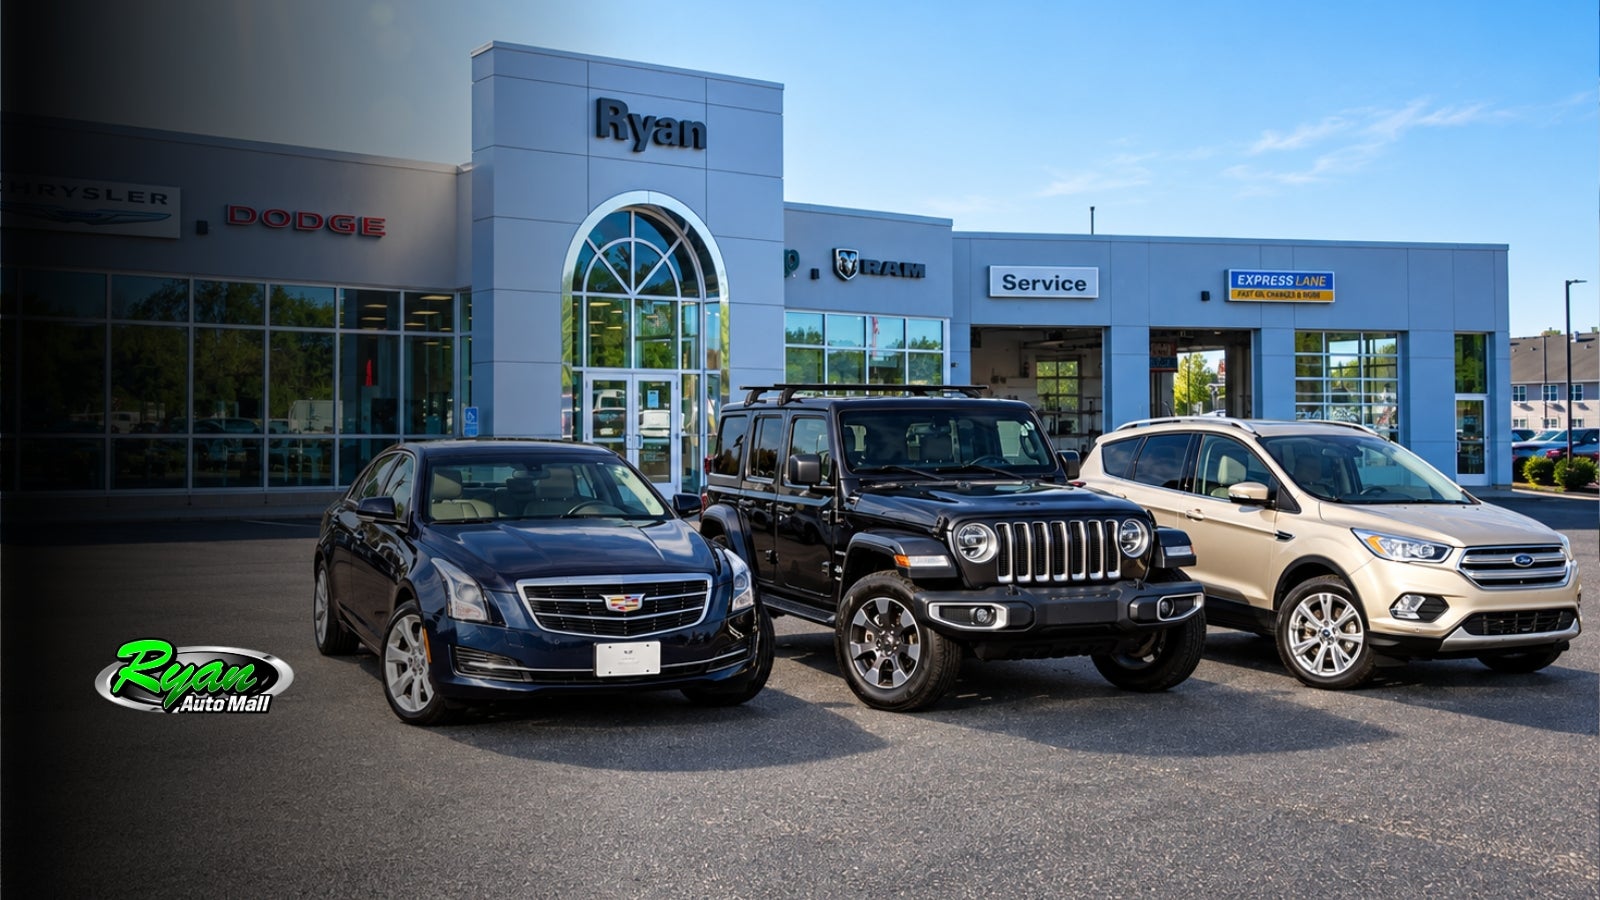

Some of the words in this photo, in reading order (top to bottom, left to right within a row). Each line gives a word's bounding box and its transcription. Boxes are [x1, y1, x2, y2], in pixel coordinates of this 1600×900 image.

[596, 97, 707, 152] Ryan
[2, 181, 168, 205] HRYSLER
[226, 204, 386, 237] DODGE
[860, 259, 926, 278] RAM
[1002, 273, 1087, 292] Service
[1238, 274, 1294, 286] EXPRESS
[1295, 276, 1327, 287] LANE
